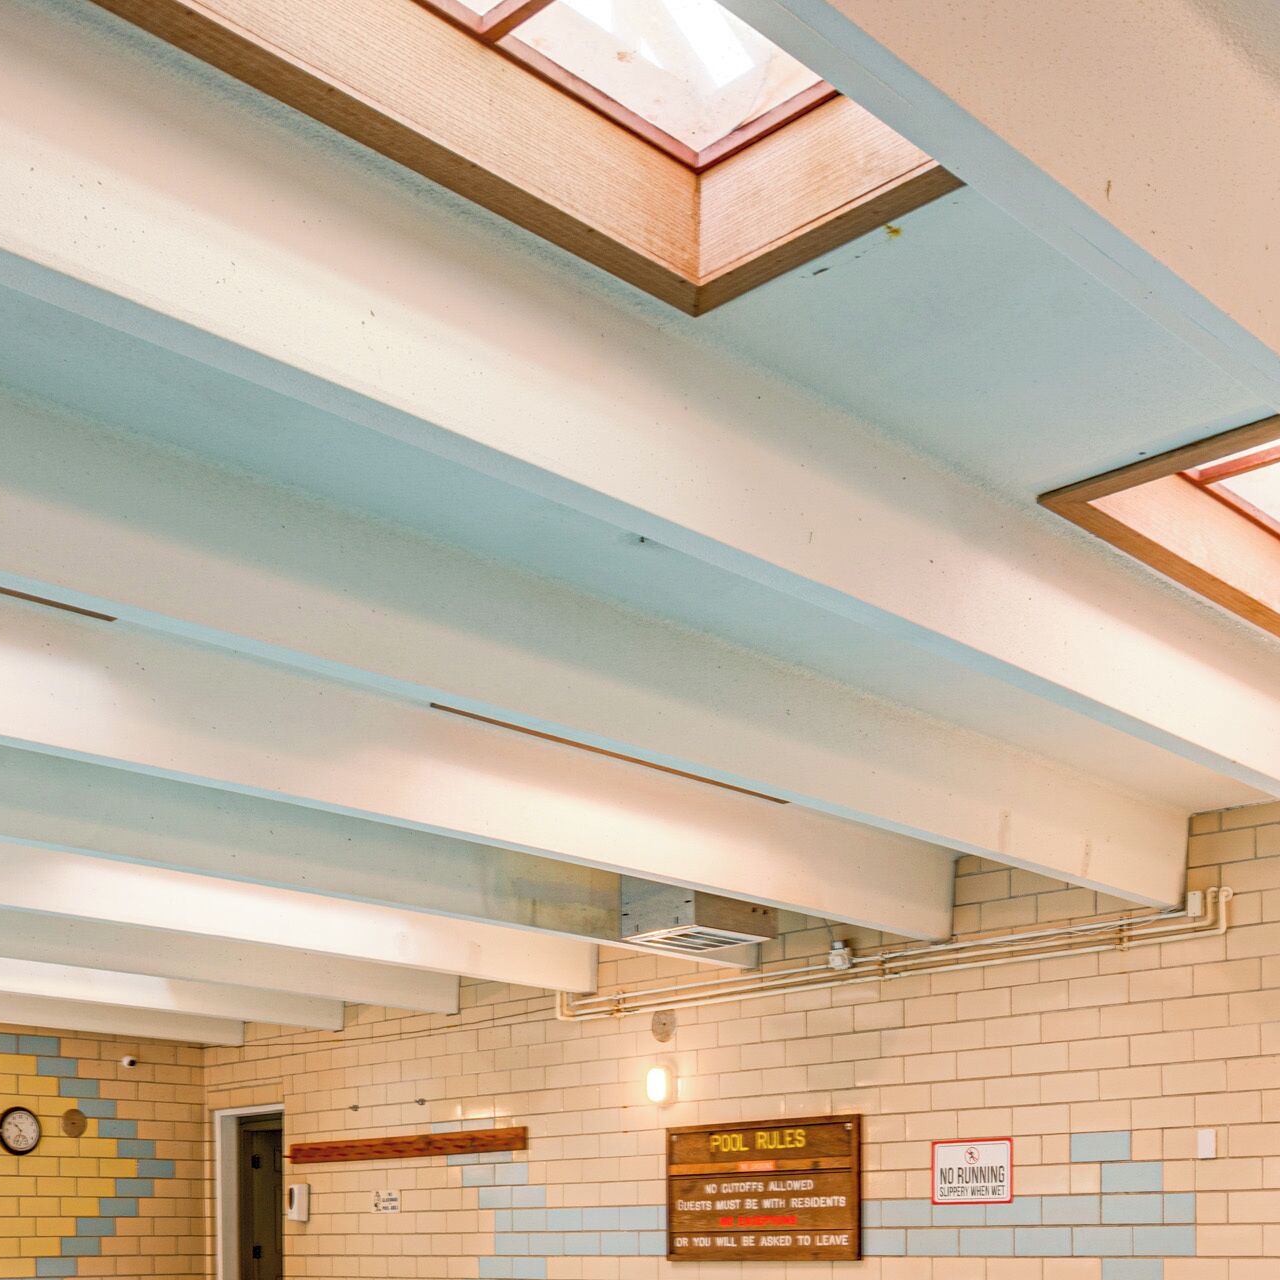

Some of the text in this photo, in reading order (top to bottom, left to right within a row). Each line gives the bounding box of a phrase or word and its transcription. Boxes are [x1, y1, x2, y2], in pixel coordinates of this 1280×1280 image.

[709, 1129, 806, 1153] POOL RULES
[940, 1166, 1005, 1184] NO RUNNING
[705, 1184, 717, 1194] NO
[768, 1180, 814, 1192] ALLOWED
[940, 1185, 1005, 1197] SLIPPERY WHEN WET
[677, 1196, 846, 1211] GUESTS MUST BE WITH RESIDENTS
[675, 1234, 849, 1247] OR YOU WILL BE ASKED TO LEAVE
